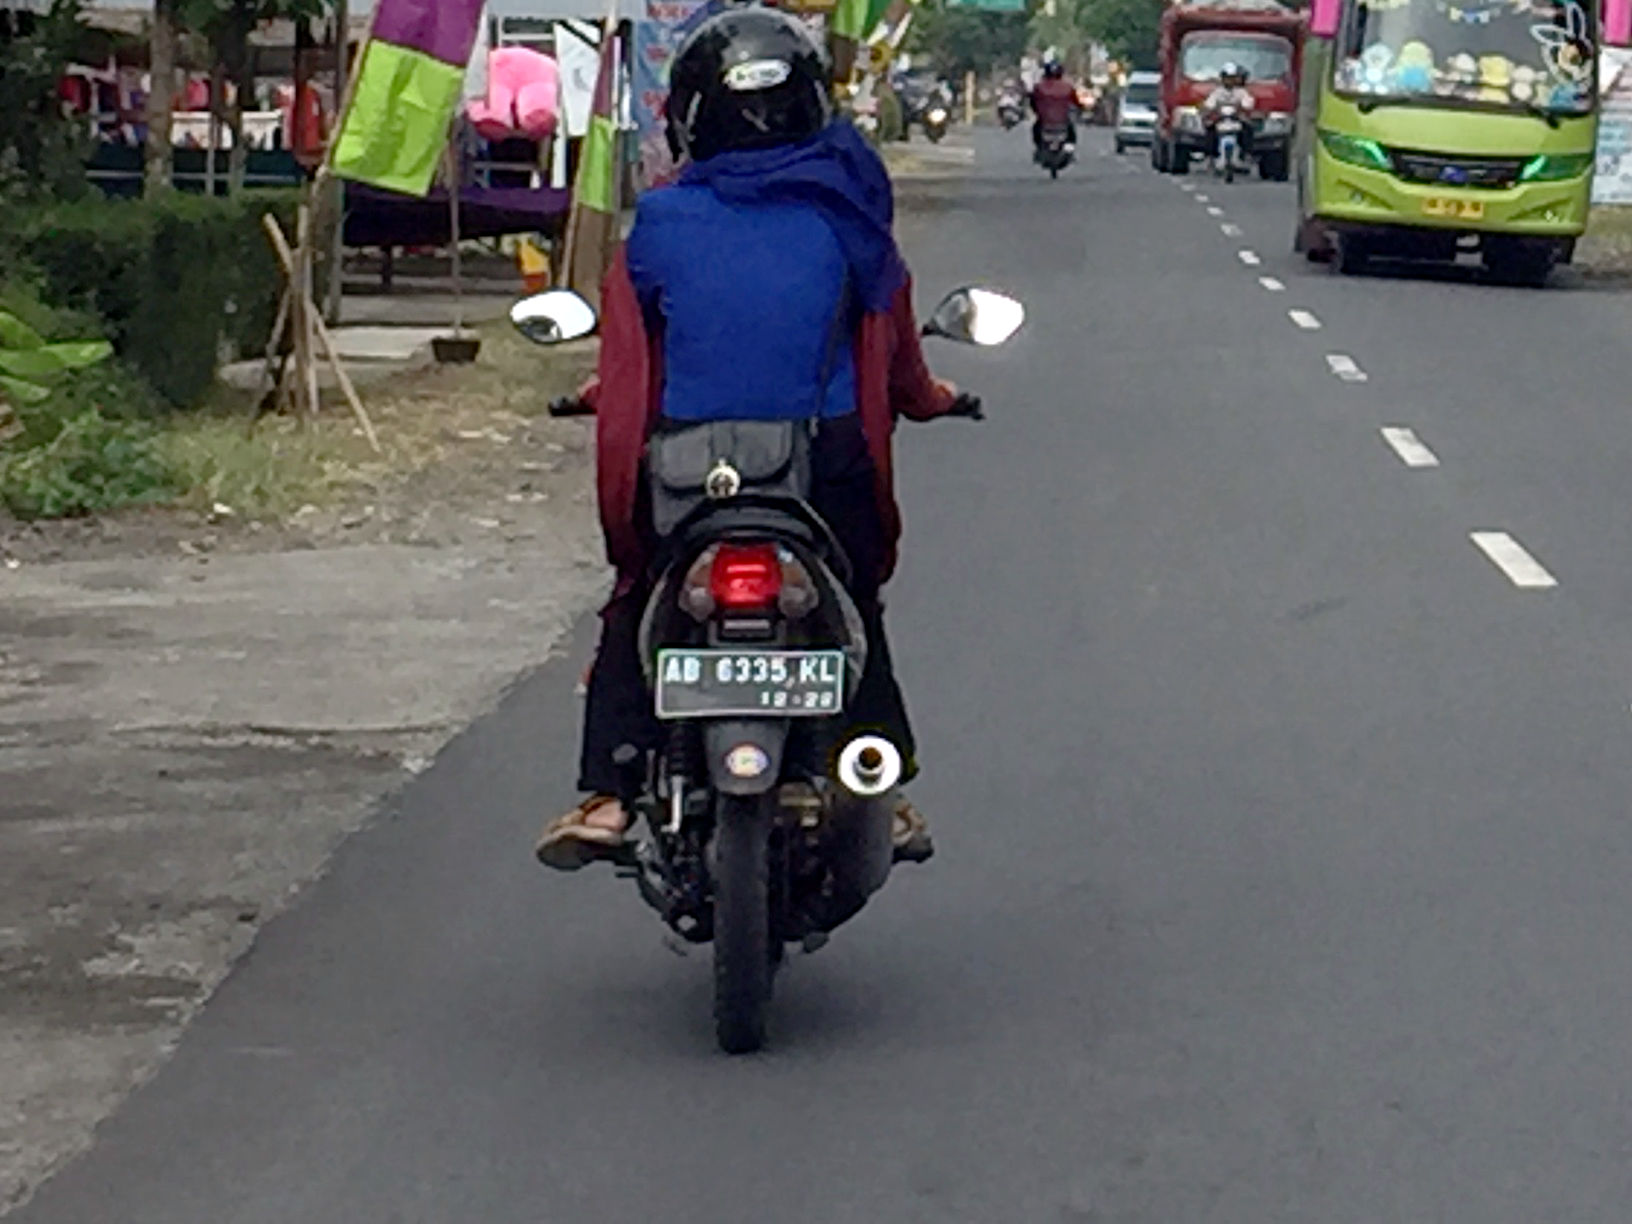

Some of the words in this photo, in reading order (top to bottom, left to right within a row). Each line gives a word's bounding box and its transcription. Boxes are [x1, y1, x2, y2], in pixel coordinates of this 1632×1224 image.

[666, 657, 700, 682] AB
[716, 657, 788, 682] 6335
[800, 657, 835, 682] KL
